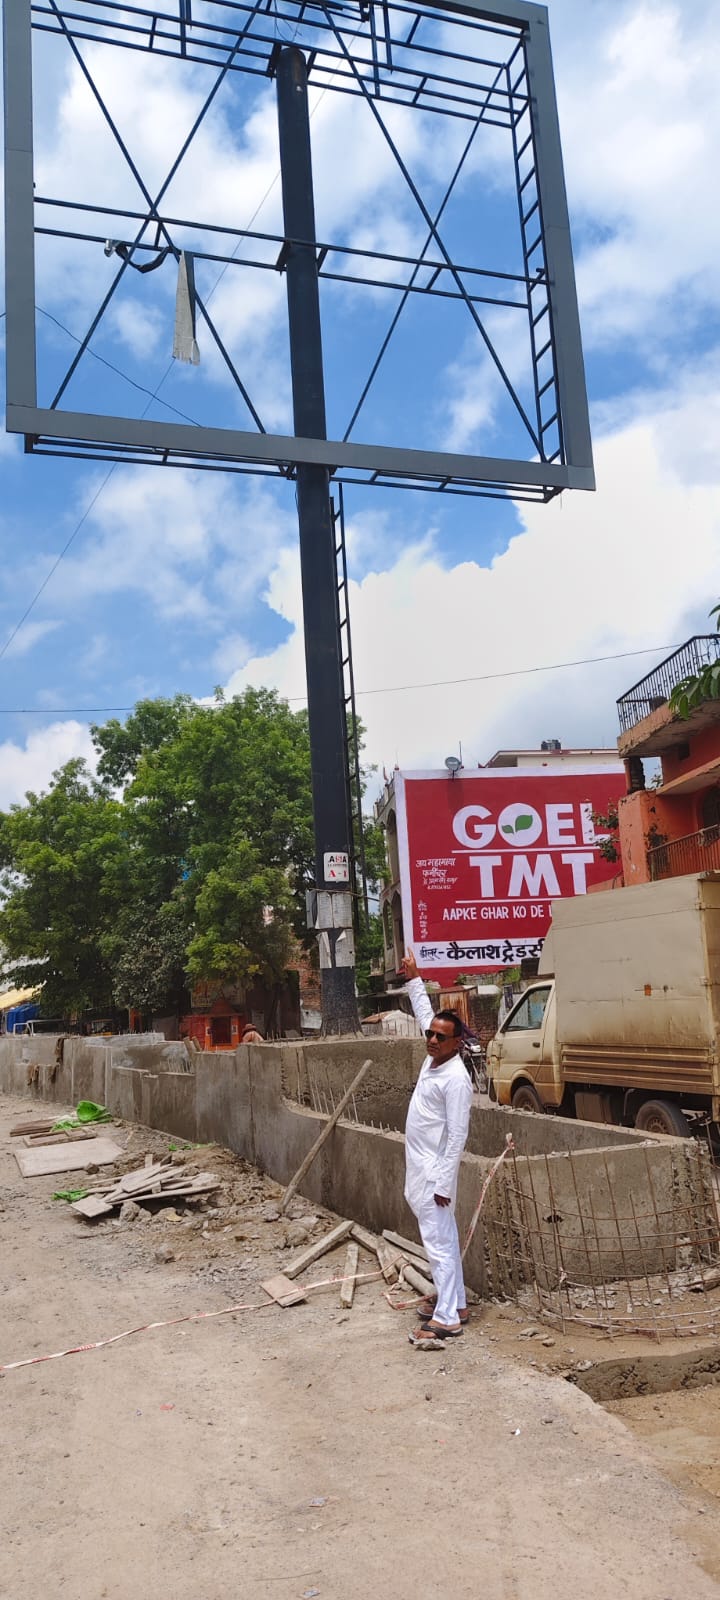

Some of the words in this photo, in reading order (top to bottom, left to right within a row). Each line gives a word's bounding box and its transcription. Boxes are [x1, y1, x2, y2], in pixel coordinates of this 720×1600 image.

[452, 802, 611, 849] GOEL
[469, 852, 595, 898] TMT
[443, 906, 477, 921] AAPKE
[480, 905, 509, 920] GHAR
[512, 904, 527, 919] KO
[530, 904, 545, 918] DE
[446, 941, 501, 960] कैलाश
